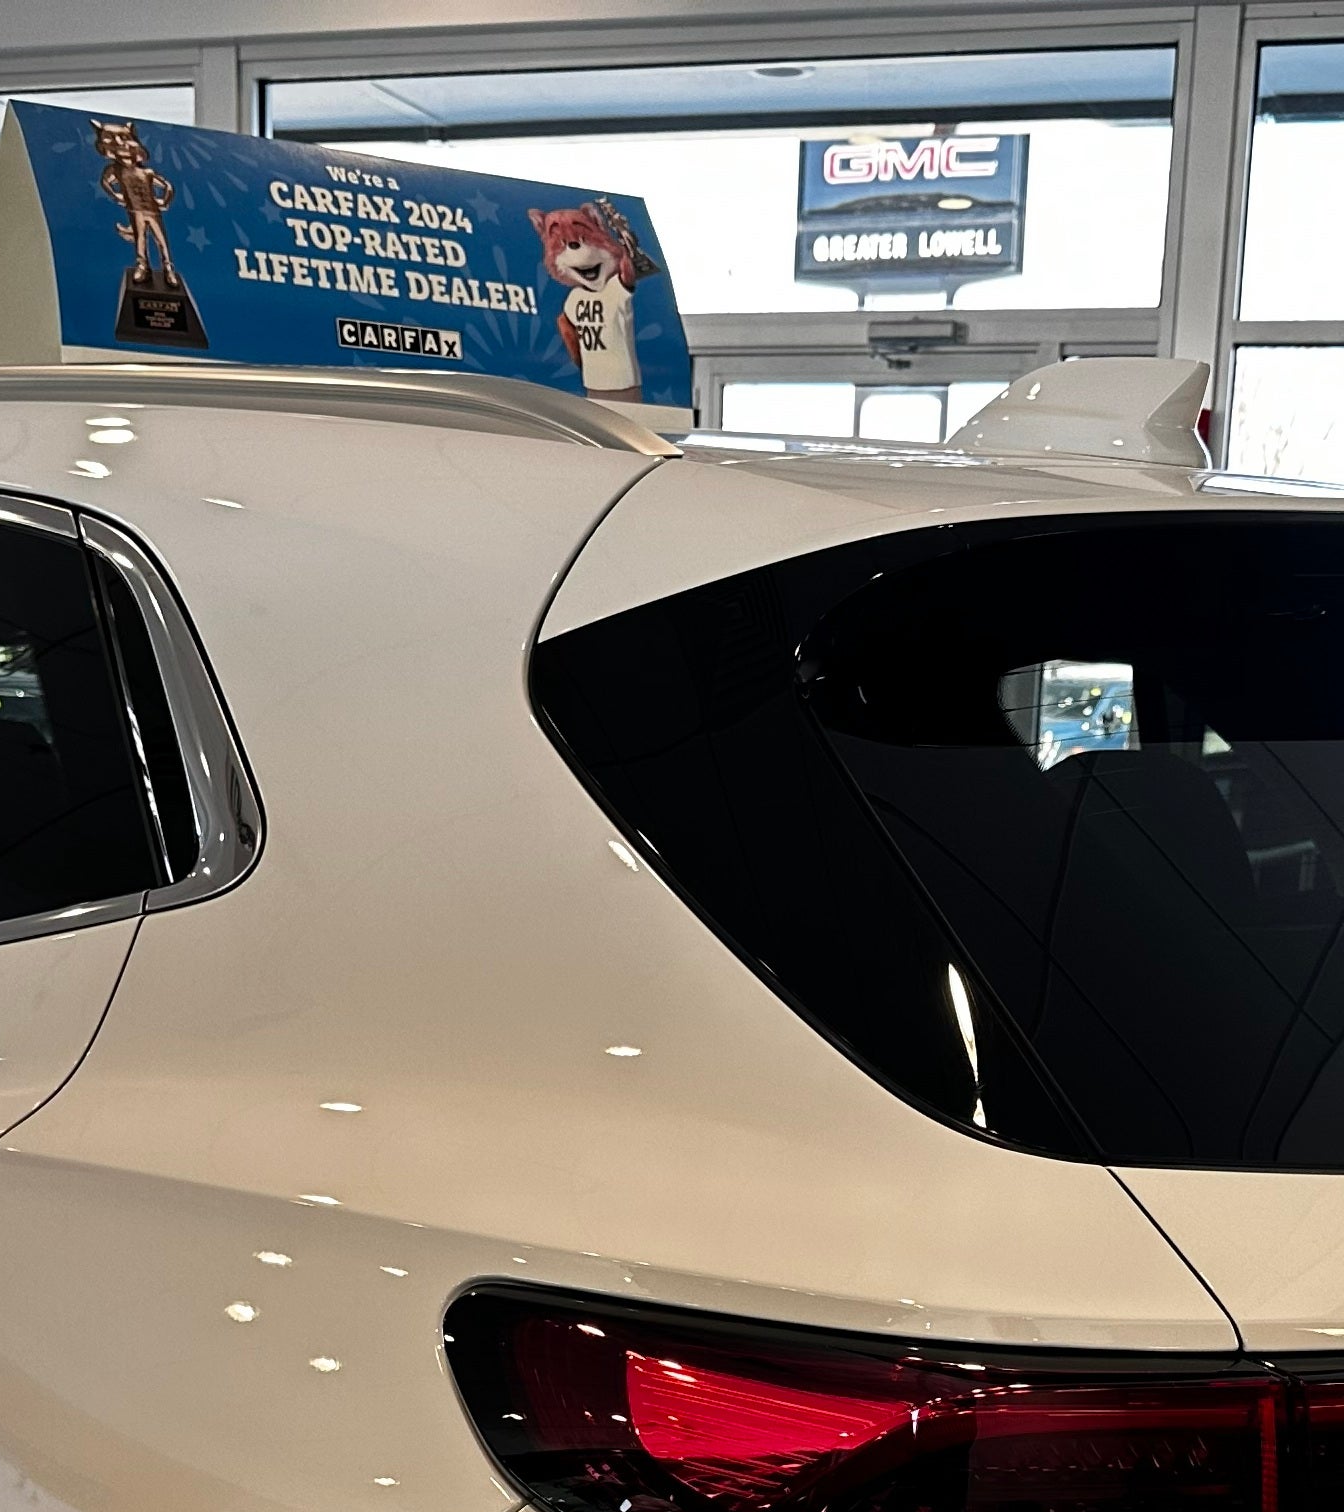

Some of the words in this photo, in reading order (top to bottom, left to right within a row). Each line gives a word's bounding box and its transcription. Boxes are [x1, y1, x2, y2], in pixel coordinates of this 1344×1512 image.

[325, 165, 383, 188] We're
[386, 176, 400, 191] a
[823, 137, 1000, 185] GMC
[269, 181, 400, 224] CARFAX
[403, 201, 473, 235] 2024
[286, 218, 467, 268] TOP-RATED
[918, 228, 1002, 258] LOWELL
[234, 249, 400, 298] LIFETIME
[404, 270, 538, 316] DEALER!
[576, 300, 603, 323] CAR
[339, 320, 461, 358] CARFAX
[577, 326, 607, 351] FOX
